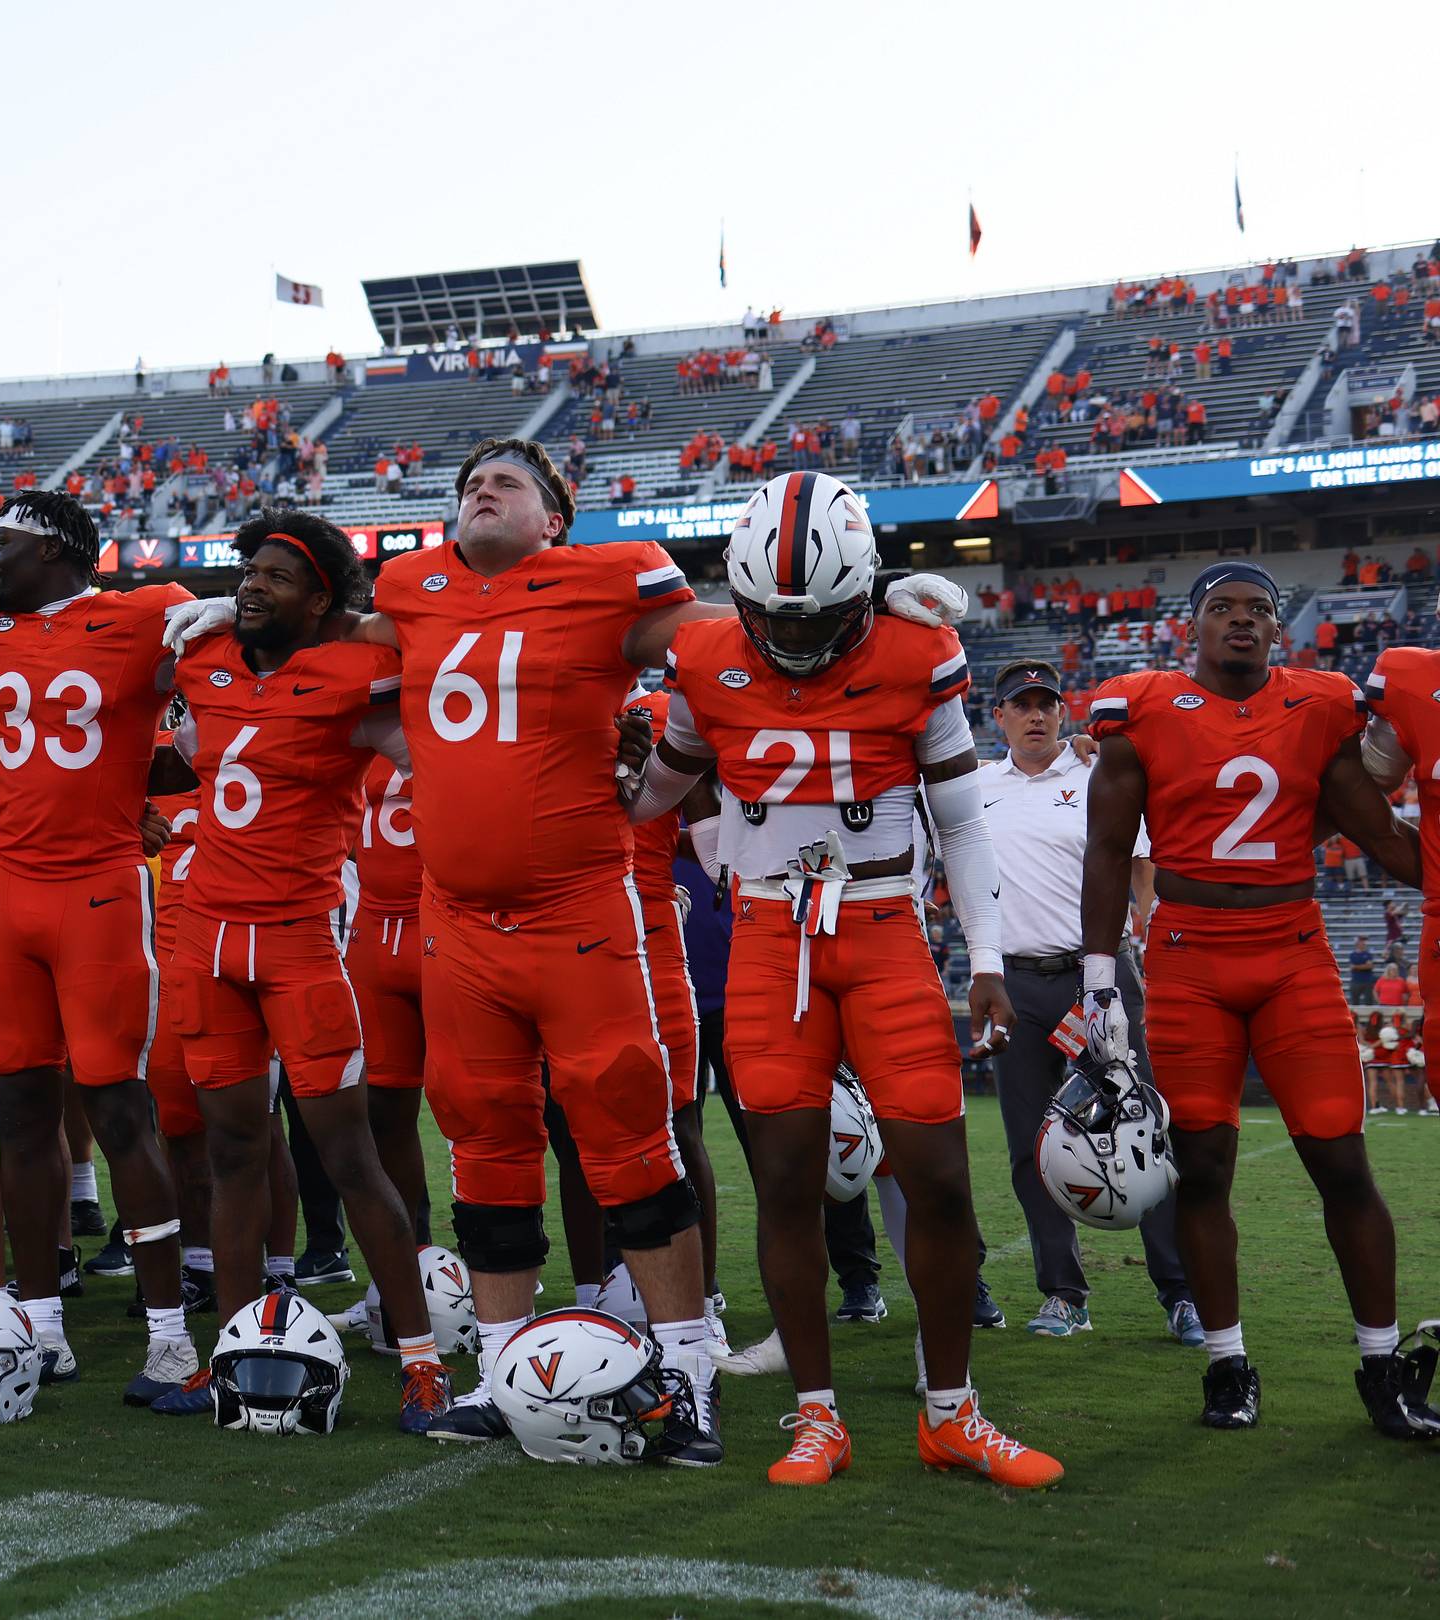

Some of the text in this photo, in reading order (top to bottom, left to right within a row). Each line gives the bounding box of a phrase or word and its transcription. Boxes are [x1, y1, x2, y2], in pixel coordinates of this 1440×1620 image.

[1250, 457, 1295, 477] LET'S
[1296, 454, 1326, 473] ALL
[1326, 450, 1364, 470] JOIN
[1366, 445, 1423, 466] HANDS
[1311, 469, 1344, 488] FOR
[1345, 465, 1377, 485] THE
[1378, 461, 1423, 482] DEAR
[618, 509, 654, 527] LET'S
[654, 507, 681, 524] ALL
[681, 505, 712, 522] JOIN
[667, 522, 692, 539] FOR
[692, 520, 722, 537] THE
[382, 534, 417, 551] 0:00
[426, 577, 445, 586] ACC
[778, 602, 805, 611] ACC
[214, 673, 229, 681] ACC
[428, 630, 524, 742] 61
[724, 672, 746, 682] ACC
[1177, 696, 1199, 705] ACC
[213, 725, 263, 829] 6
[745, 728, 855, 804] 21
[1211, 755, 1280, 861] 2
[60, 1268, 80, 1291] NIKE
[438, 1261, 464, 1293] V
[259, 1336, 285, 1346] ACC
[528, 1350, 565, 1394] V
[255, 1412, 280, 1422] Riddell
